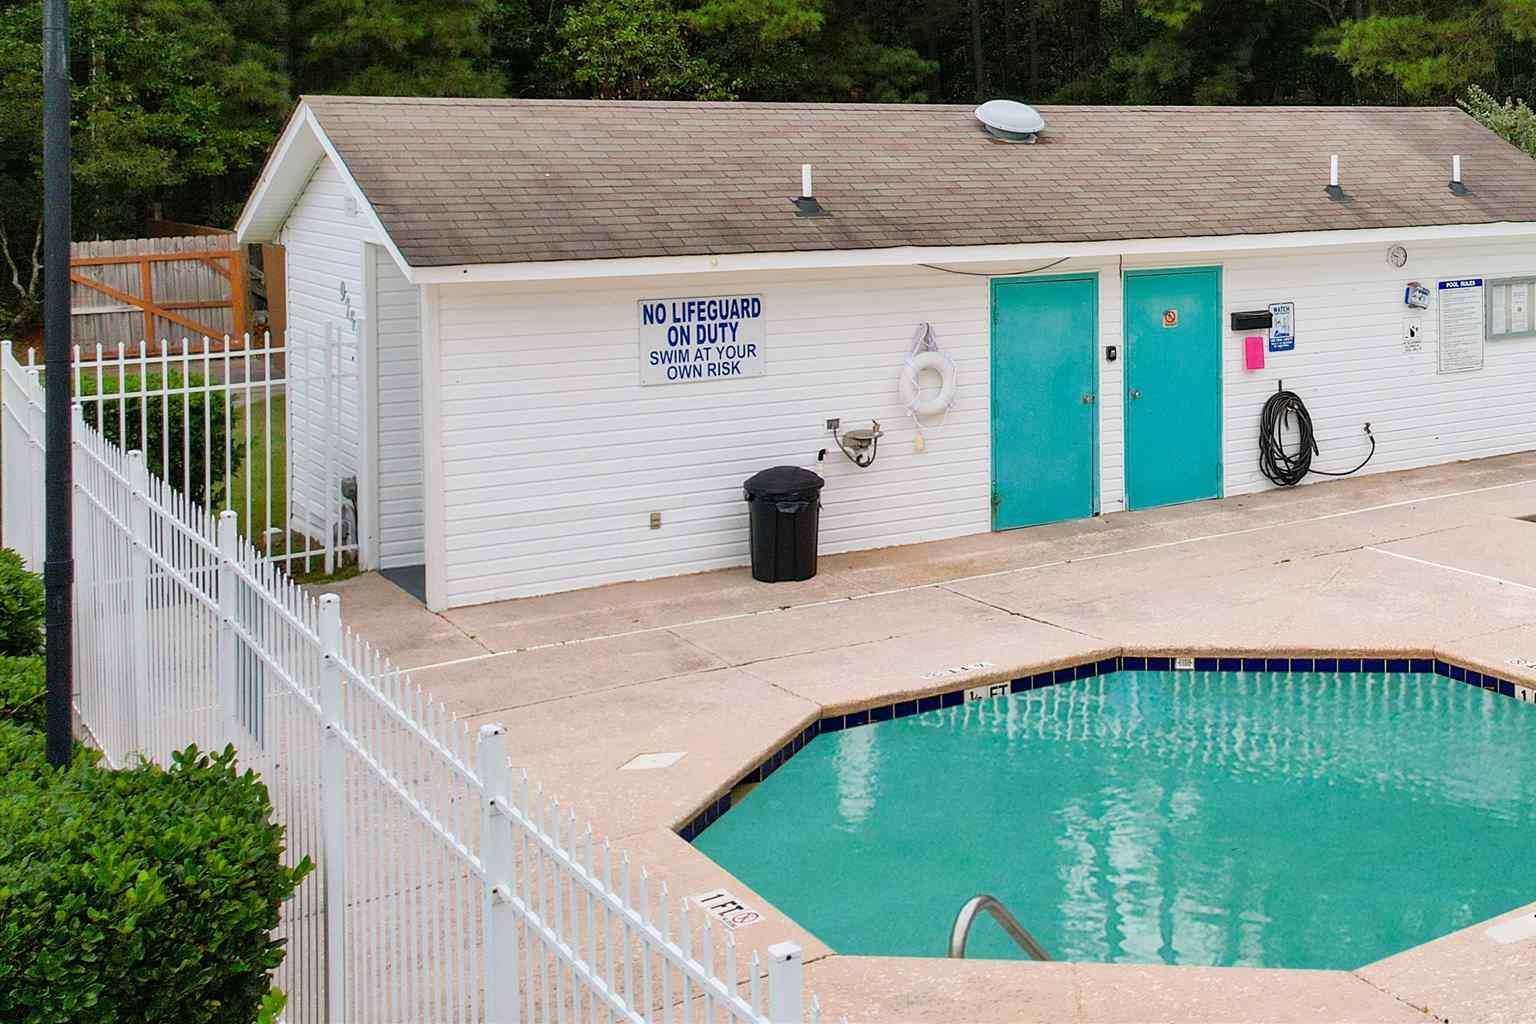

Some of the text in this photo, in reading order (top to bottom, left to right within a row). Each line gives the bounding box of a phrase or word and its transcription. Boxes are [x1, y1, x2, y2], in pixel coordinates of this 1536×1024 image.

[643, 297, 761, 325] NO LIFEGUARD
[667, 321, 739, 347] ON DUTY
[650, 343, 757, 365] SWIM AT YOUR
[667, 360, 741, 380] OWN RISK
[989, 684, 1009, 699] FT
[1521, 689, 1527, 702] 1
[701, 894, 744, 917] 1 FT
